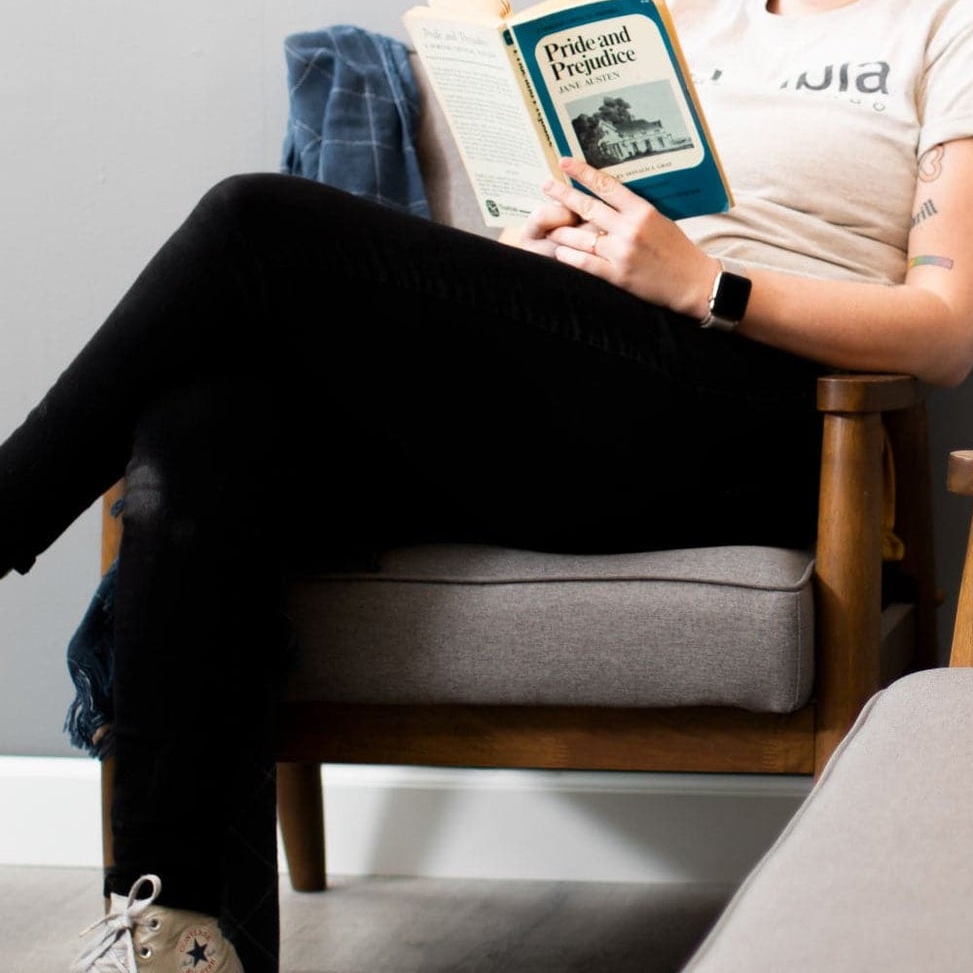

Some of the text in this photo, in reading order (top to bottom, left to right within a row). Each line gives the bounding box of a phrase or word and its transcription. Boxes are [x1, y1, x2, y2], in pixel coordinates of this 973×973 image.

[543, 24, 632, 62] Pride and
[550, 47, 637, 81] Prejudice
[558, 70, 621, 94] JANE AUSTEN
